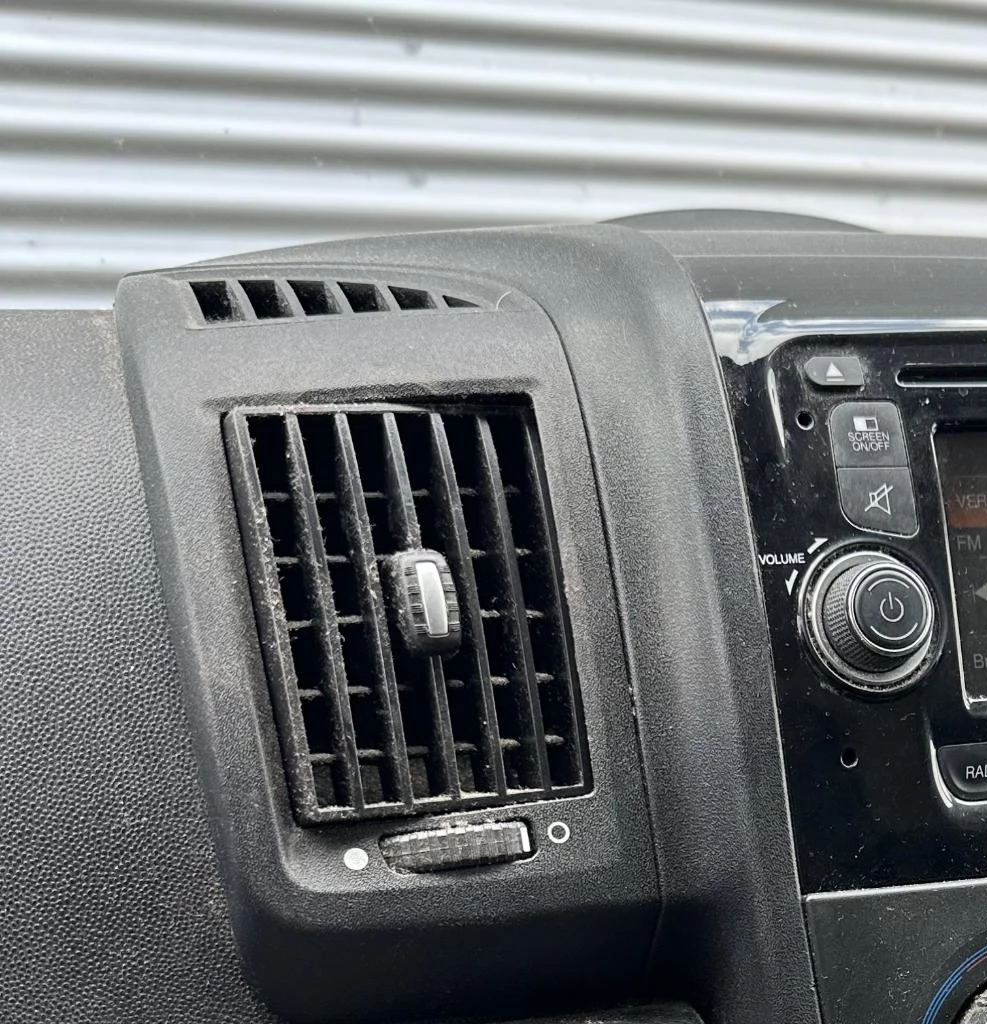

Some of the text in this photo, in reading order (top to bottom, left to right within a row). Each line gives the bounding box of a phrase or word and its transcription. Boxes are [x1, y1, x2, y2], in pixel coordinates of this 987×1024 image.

[847, 431, 890, 443] SCREEN
[852, 440, 891, 452] ON/OFF
[956, 535, 982, 551] FM
[758, 553, 806, 566] VOLUME
